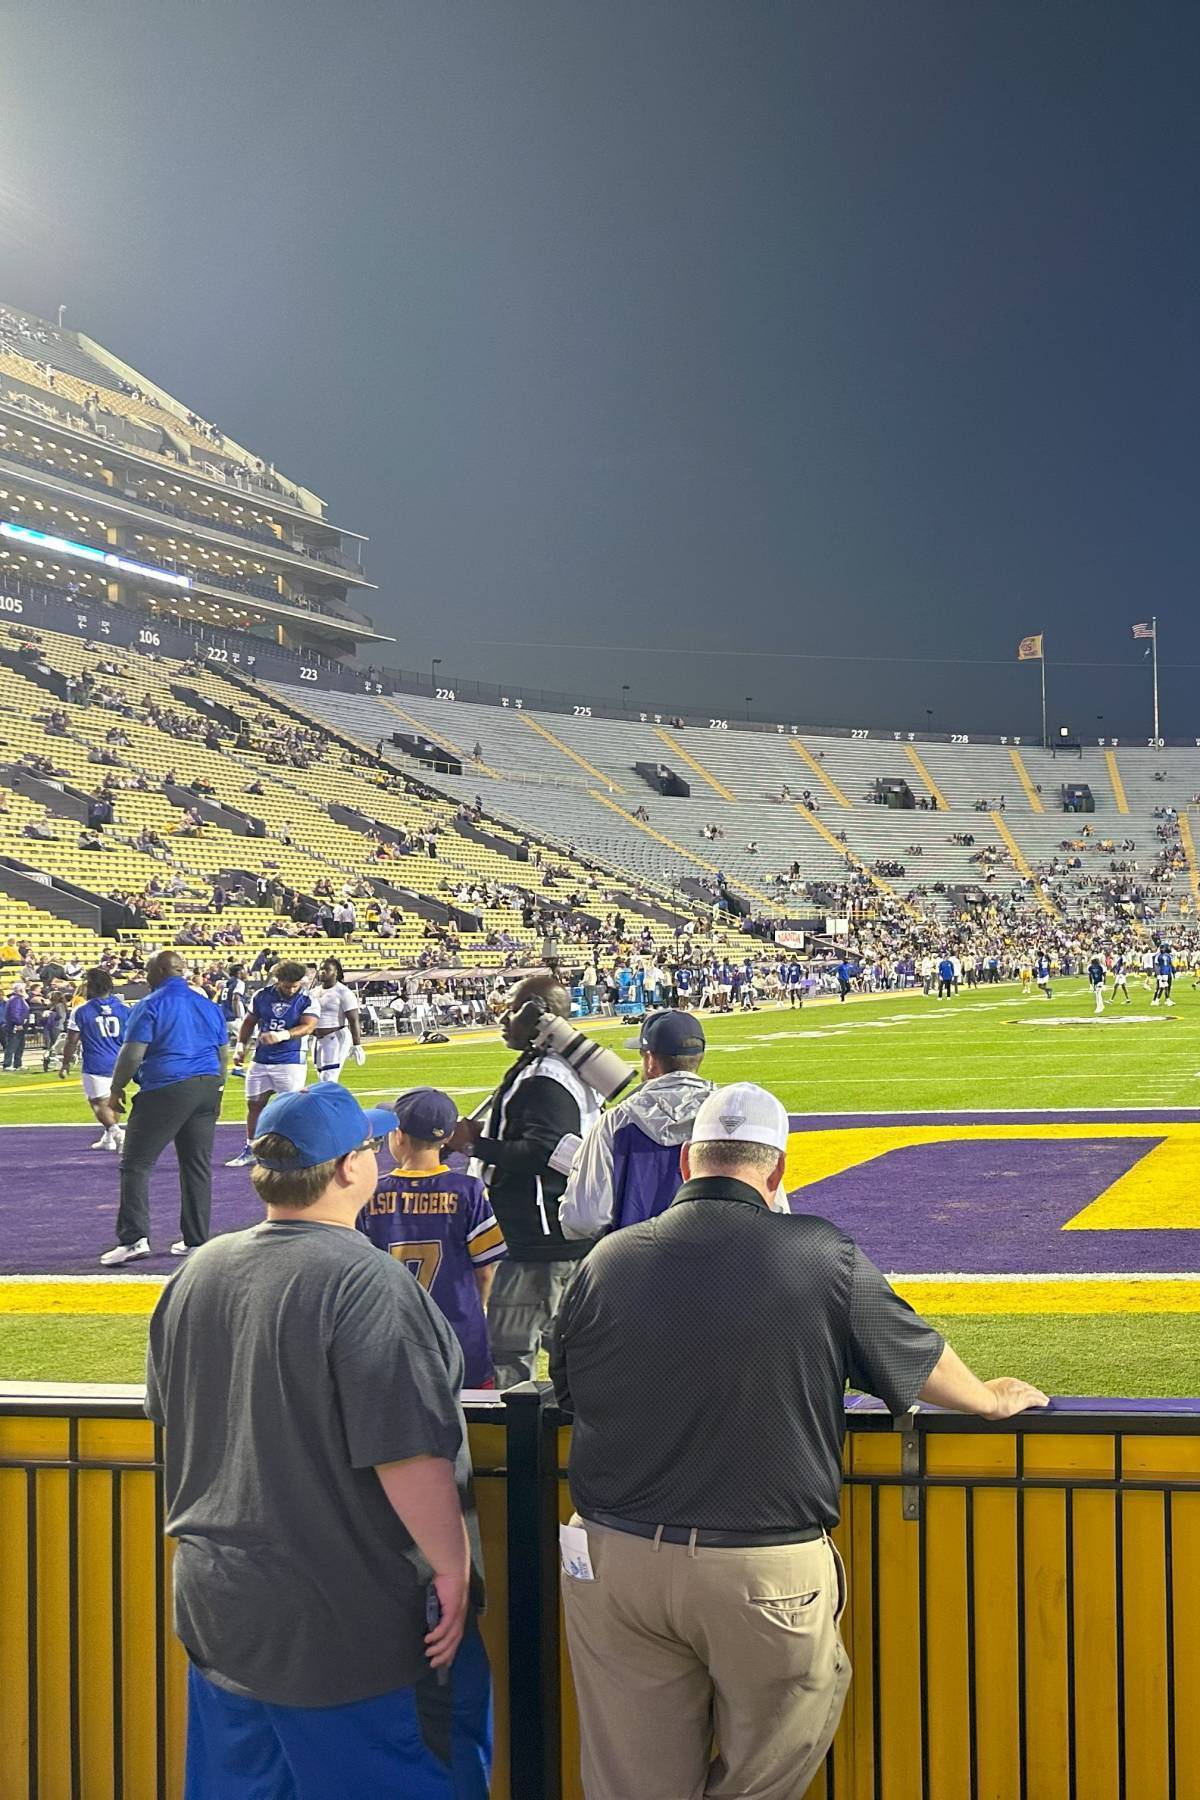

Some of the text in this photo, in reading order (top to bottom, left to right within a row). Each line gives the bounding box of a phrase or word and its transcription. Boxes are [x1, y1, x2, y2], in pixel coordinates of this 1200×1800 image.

[0, 596, 23, 613] 105
[139, 630, 160, 646] 106
[208, 647, 228, 663] 222
[300, 667, 317, 681] 223
[436, 689, 455, 700] 224
[573, 706, 592, 717] 225
[709, 719, 728, 730] 226
[851, 729, 869, 739] 227
[951, 734, 969, 744] 228
[221, 988, 229, 1001] 6
[96, 1016, 120, 1037] 10
[270, 1019, 286, 1031] 52
[369, 1191, 459, 1216] LSU TIGERS
